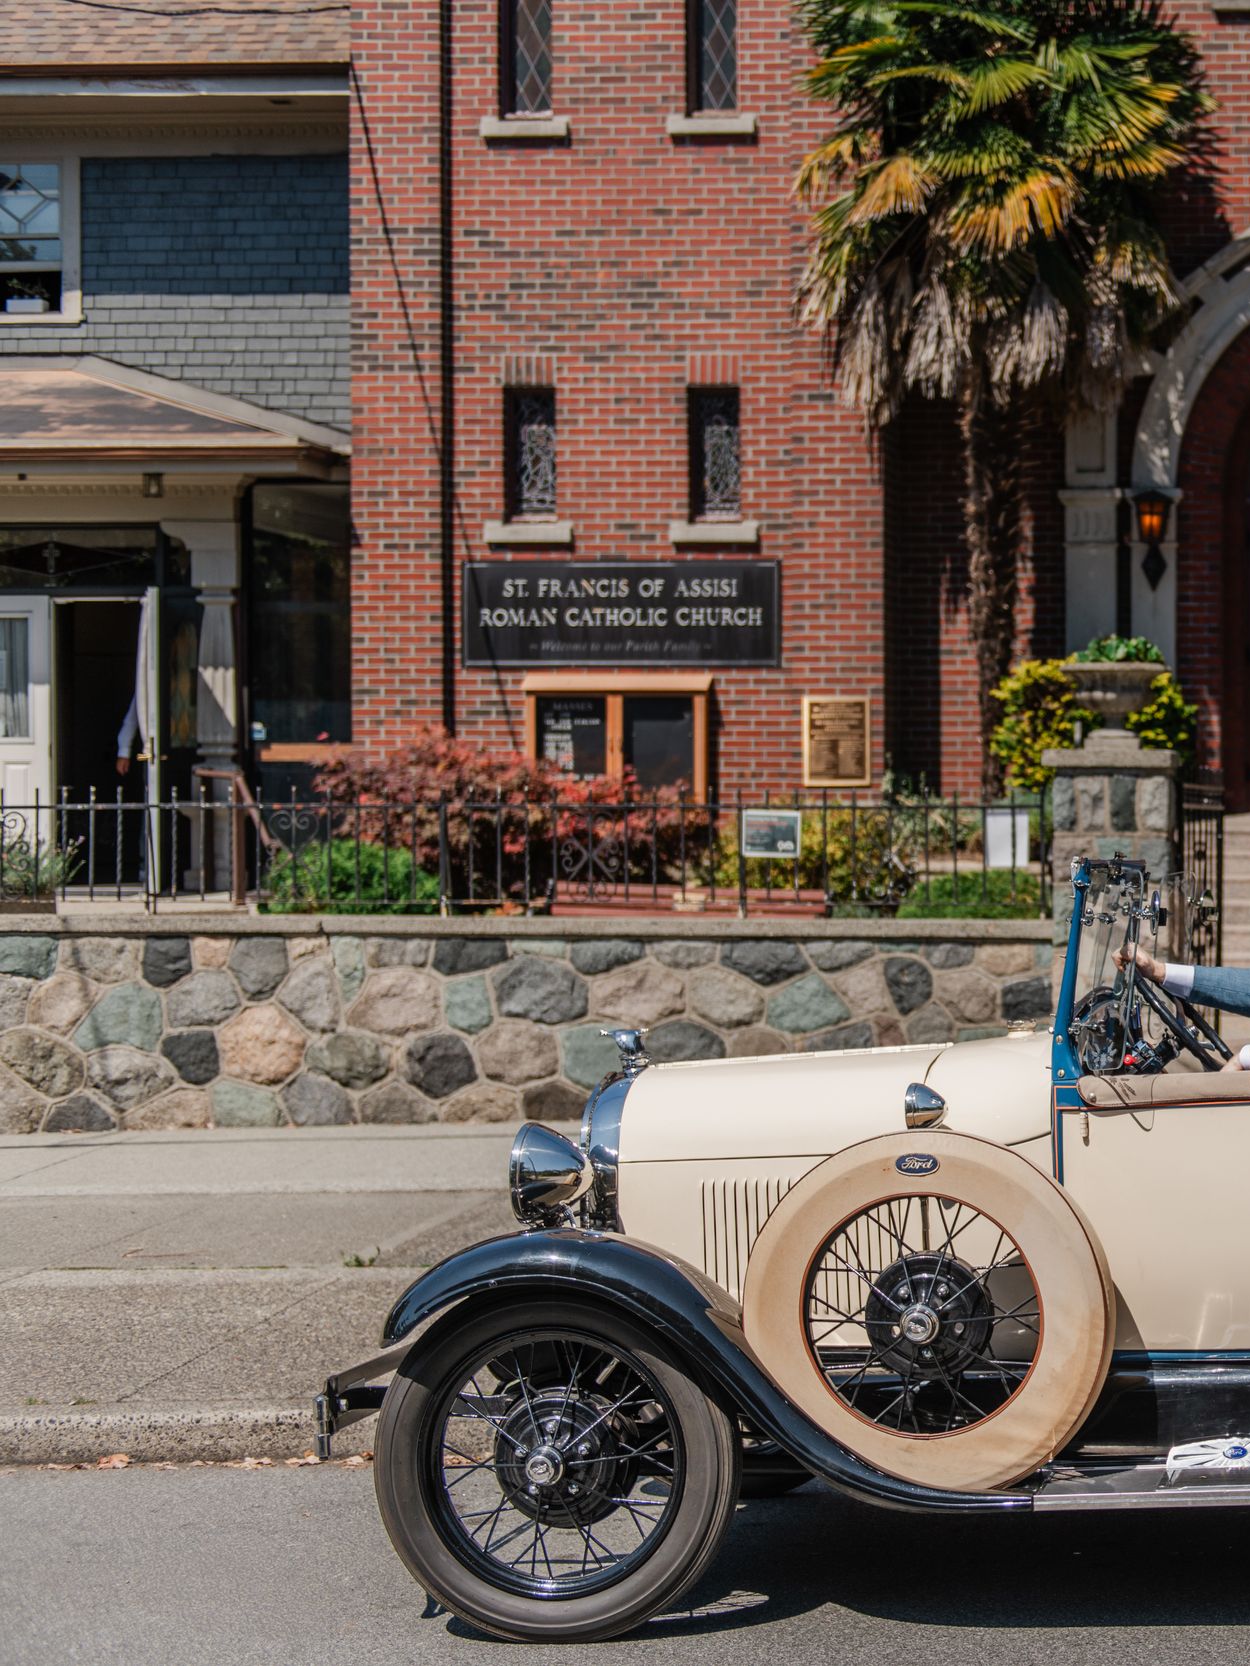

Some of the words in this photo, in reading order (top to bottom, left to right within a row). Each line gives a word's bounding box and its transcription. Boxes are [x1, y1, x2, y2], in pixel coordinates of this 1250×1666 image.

[502, 578, 530, 598] ST.
[537, 578, 630, 598] FRANCIS
[638, 578, 665, 598] OF
[674, 578, 738, 598] ASSISI
[479, 607, 557, 627] ROMAN
[564, 607, 668, 627] CATHOLIC
[674, 607, 763, 627] CHURCH
[901, 1156, 934, 1170] Ford
